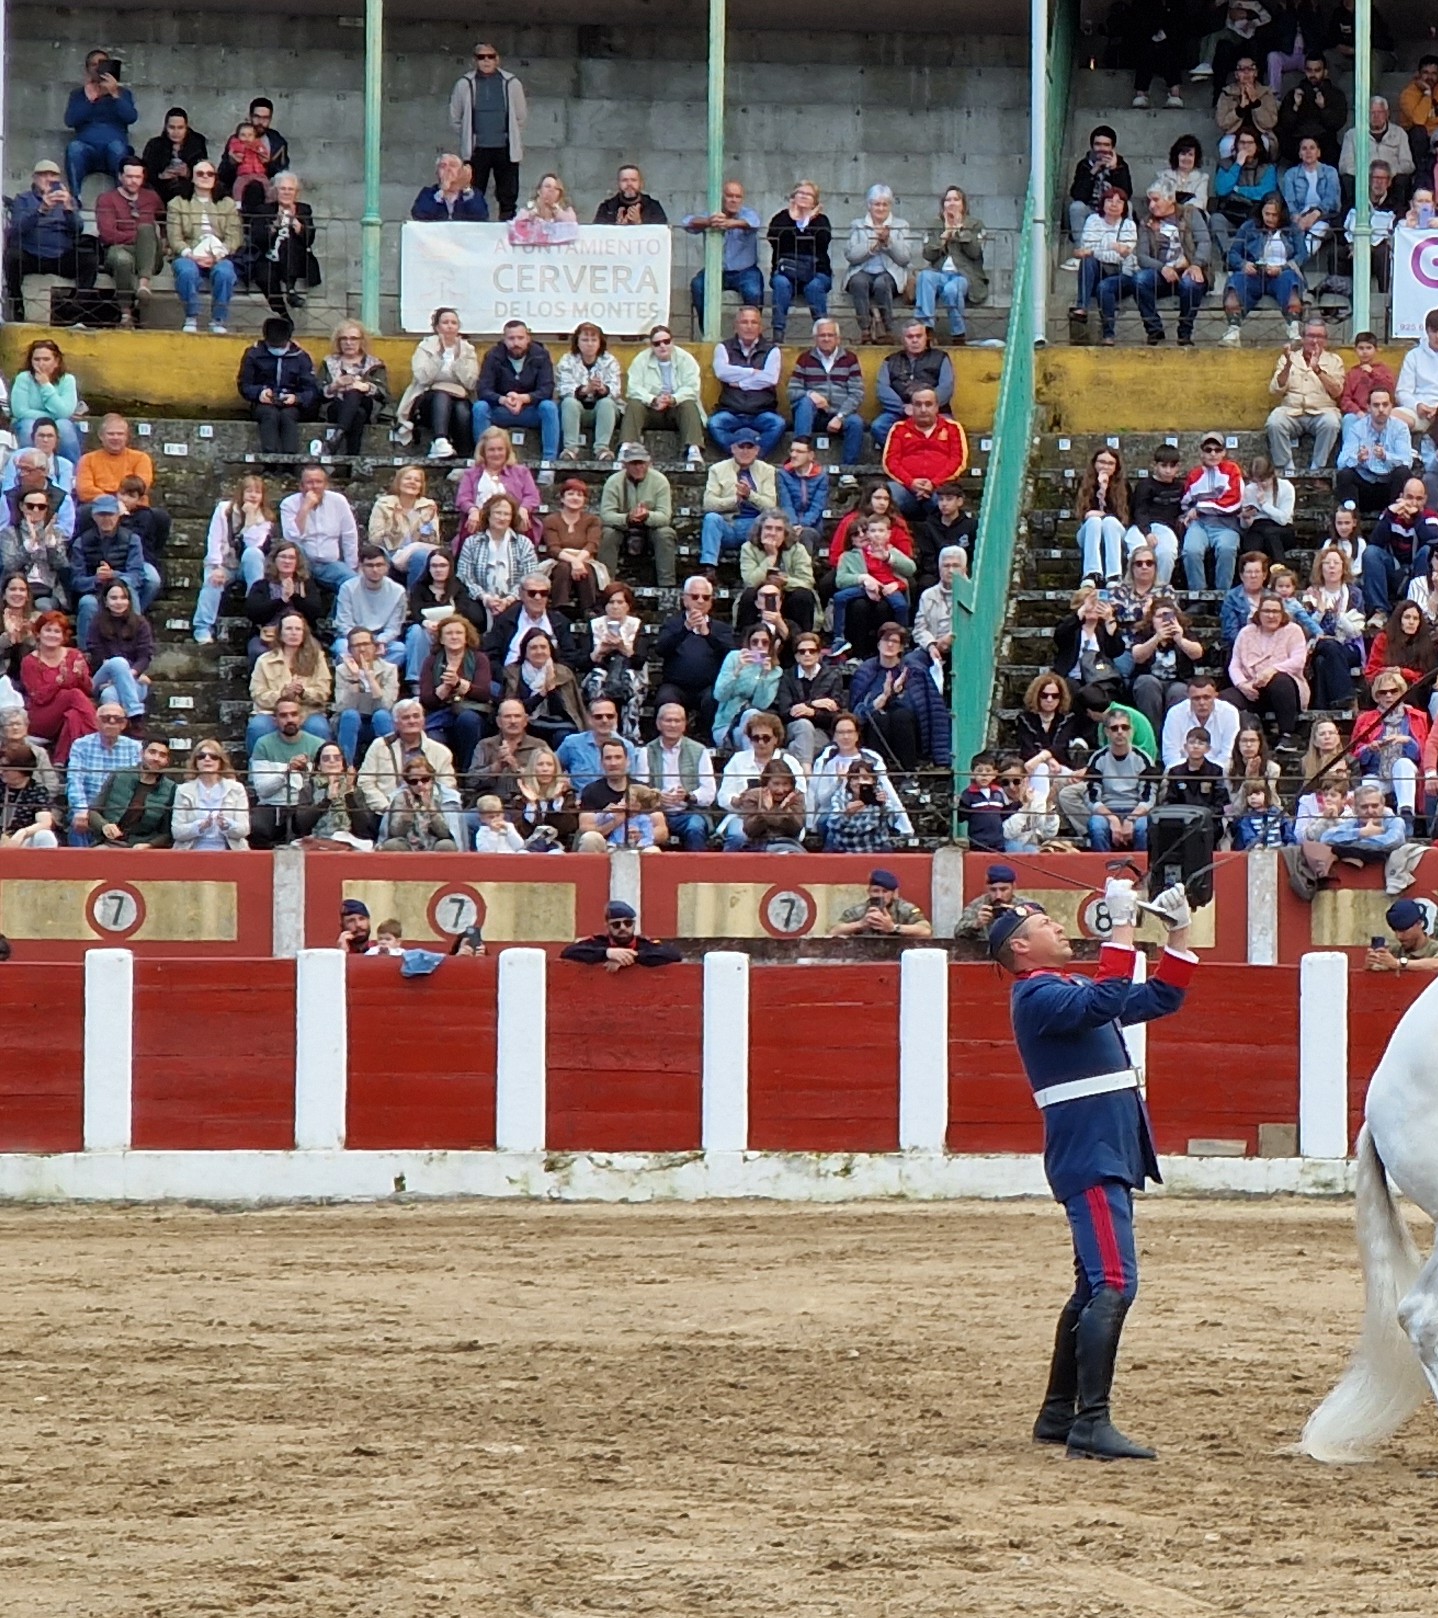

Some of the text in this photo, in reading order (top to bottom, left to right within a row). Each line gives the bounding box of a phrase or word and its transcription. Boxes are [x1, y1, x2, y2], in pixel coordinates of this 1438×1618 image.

[492, 263, 659, 294] CERVERA
[494, 301, 659, 320] DE LOS MONTES
[106, 895, 125, 926] 7
[448, 898, 466, 927] 7
[780, 898, 797, 930] 7
[1094, 901, 1113, 931] 8
